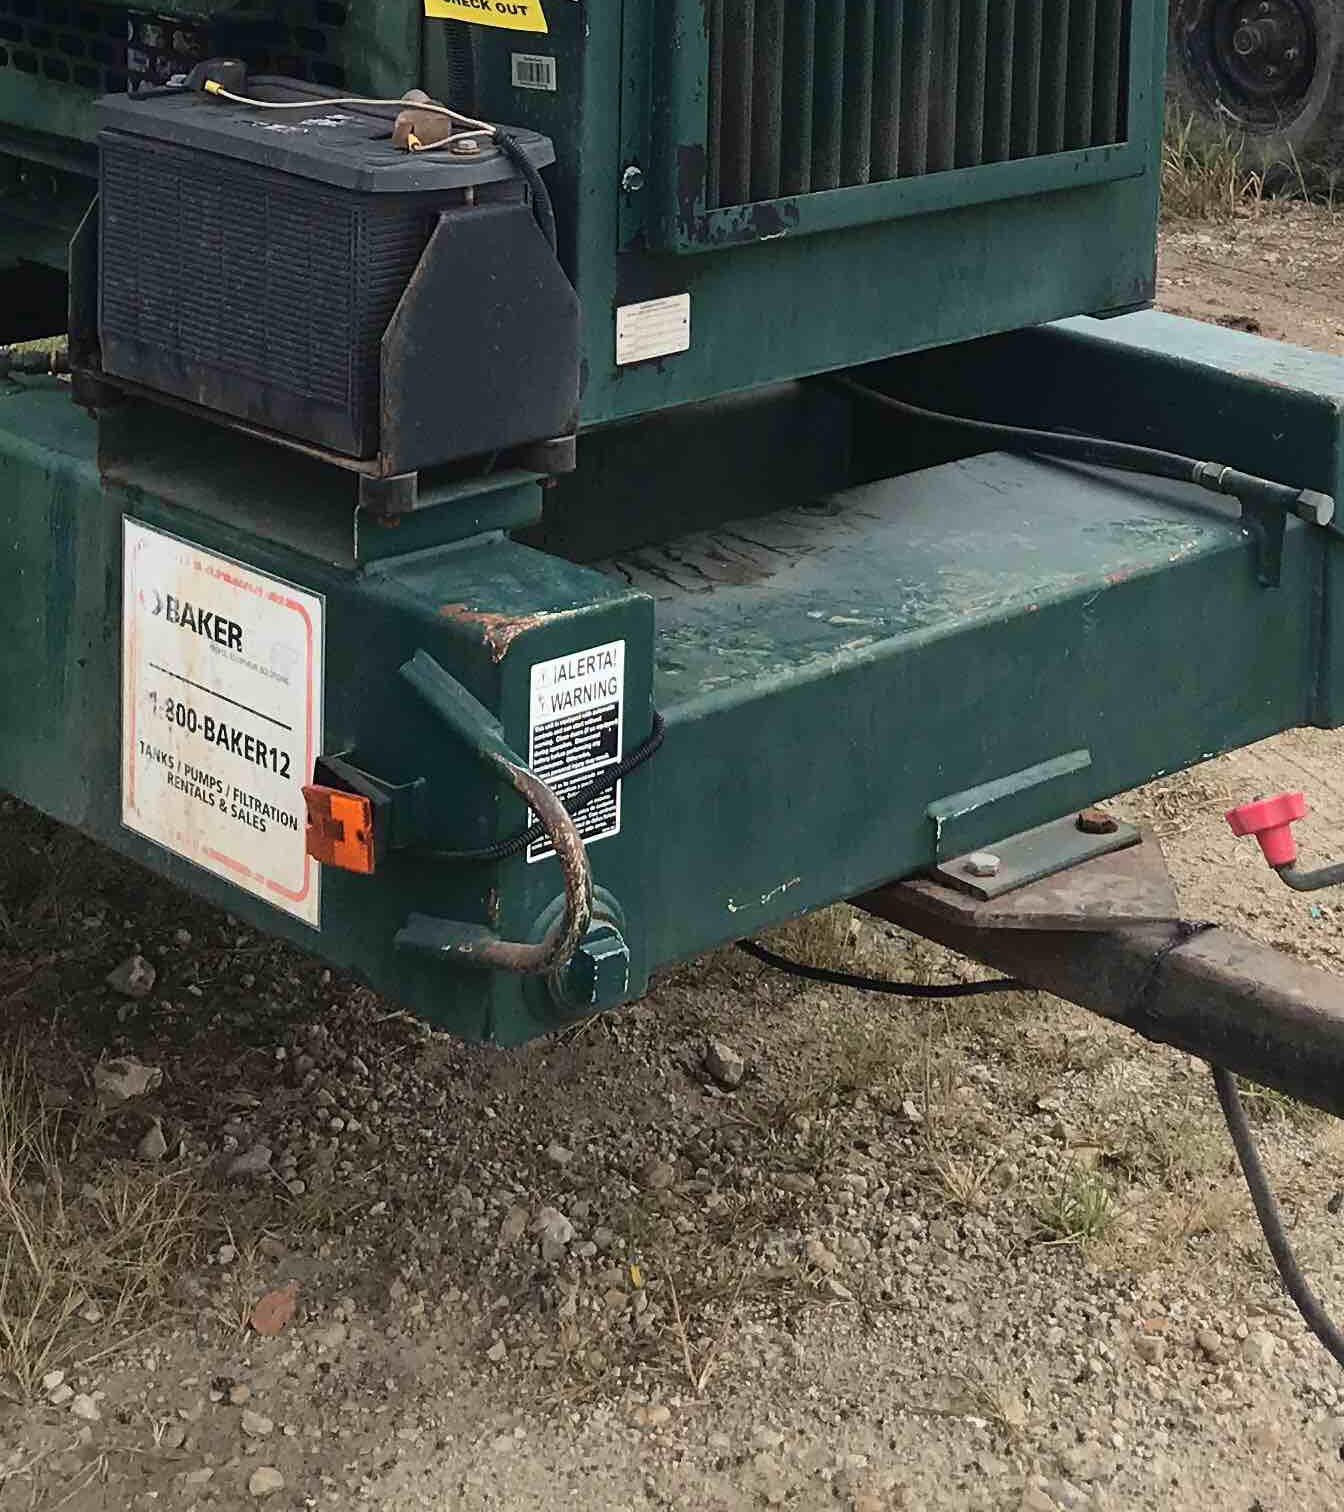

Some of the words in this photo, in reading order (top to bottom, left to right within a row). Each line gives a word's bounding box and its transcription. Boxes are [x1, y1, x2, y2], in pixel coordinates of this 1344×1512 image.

[495, 0, 529, 17] OUT
[166, 594, 243, 653] BAKER
[551, 676, 618, 713] WARNING
[149, 691, 292, 780] 1-800-BAKER12
[139, 740, 174, 771] TANKS
[184, 762, 223, 794] PUMPS
[233, 787, 298, 831] FILTRATION
[167, 773, 215, 807] RENTALS
[219, 798, 228, 813] &
[231, 804, 267, 833] SALES
